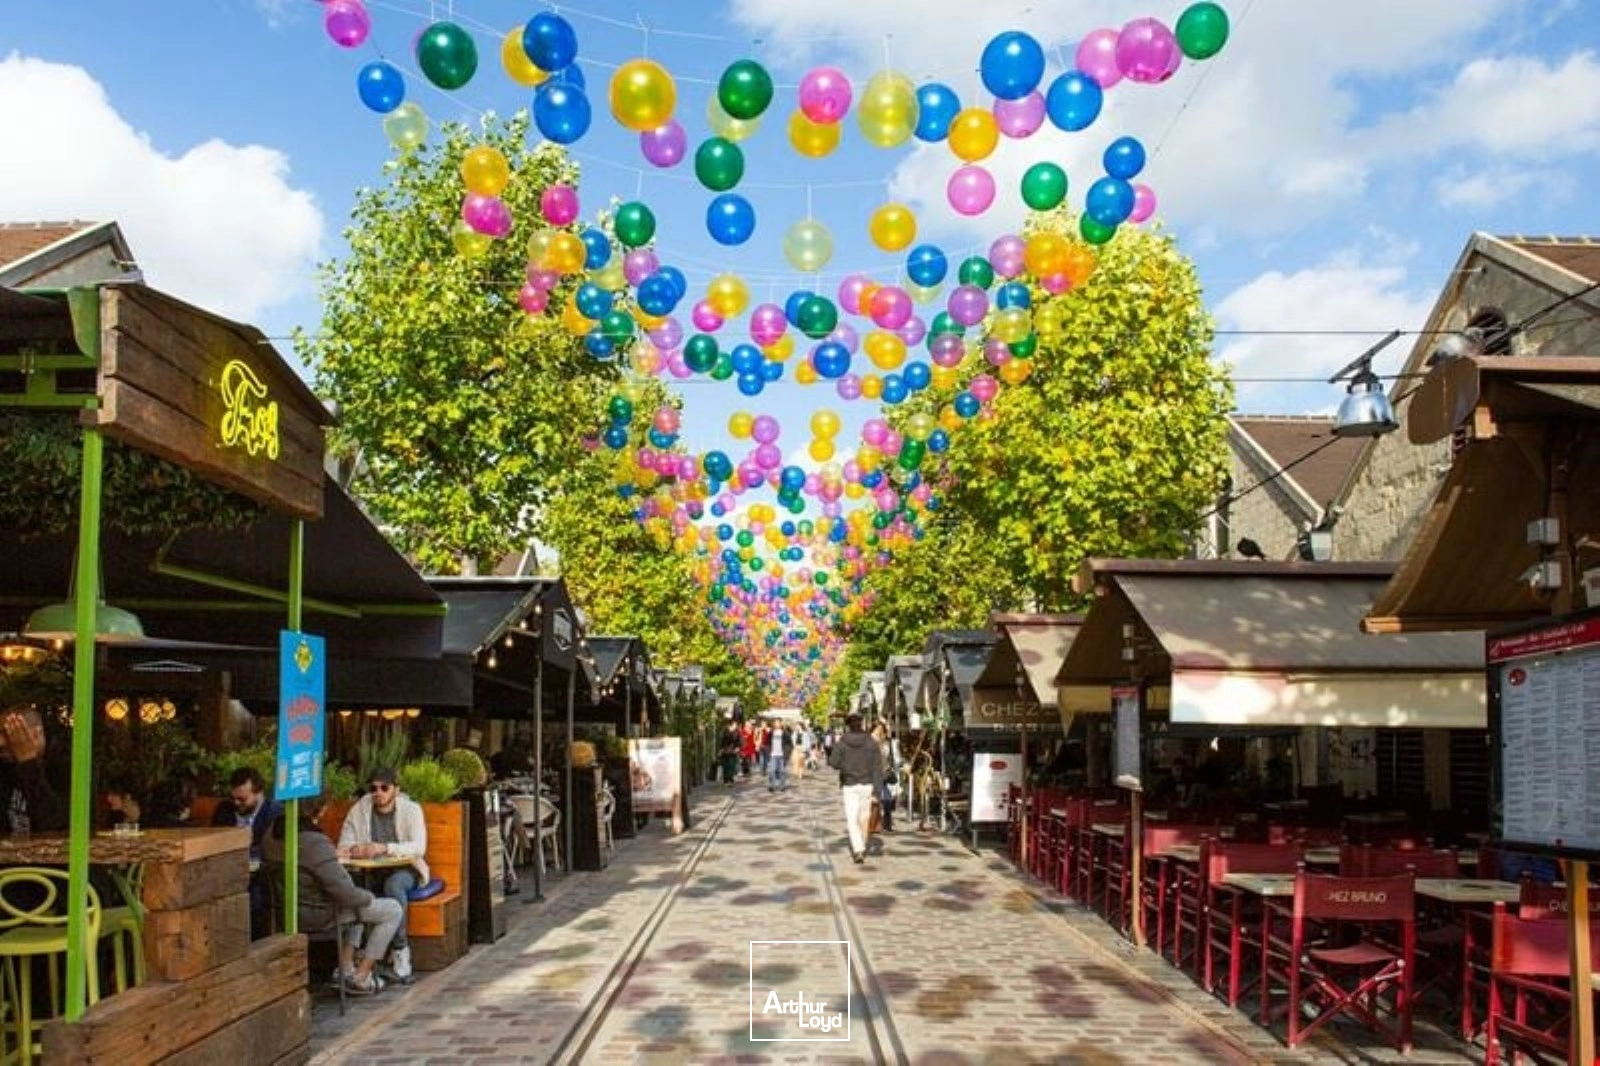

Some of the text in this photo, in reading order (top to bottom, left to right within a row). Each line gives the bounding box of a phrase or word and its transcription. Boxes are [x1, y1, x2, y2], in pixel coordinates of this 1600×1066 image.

[220, 360, 279, 460] Frog
[981, 703, 1038, 717] CHEZ
[1350, 890, 1386, 904] BRUNO
